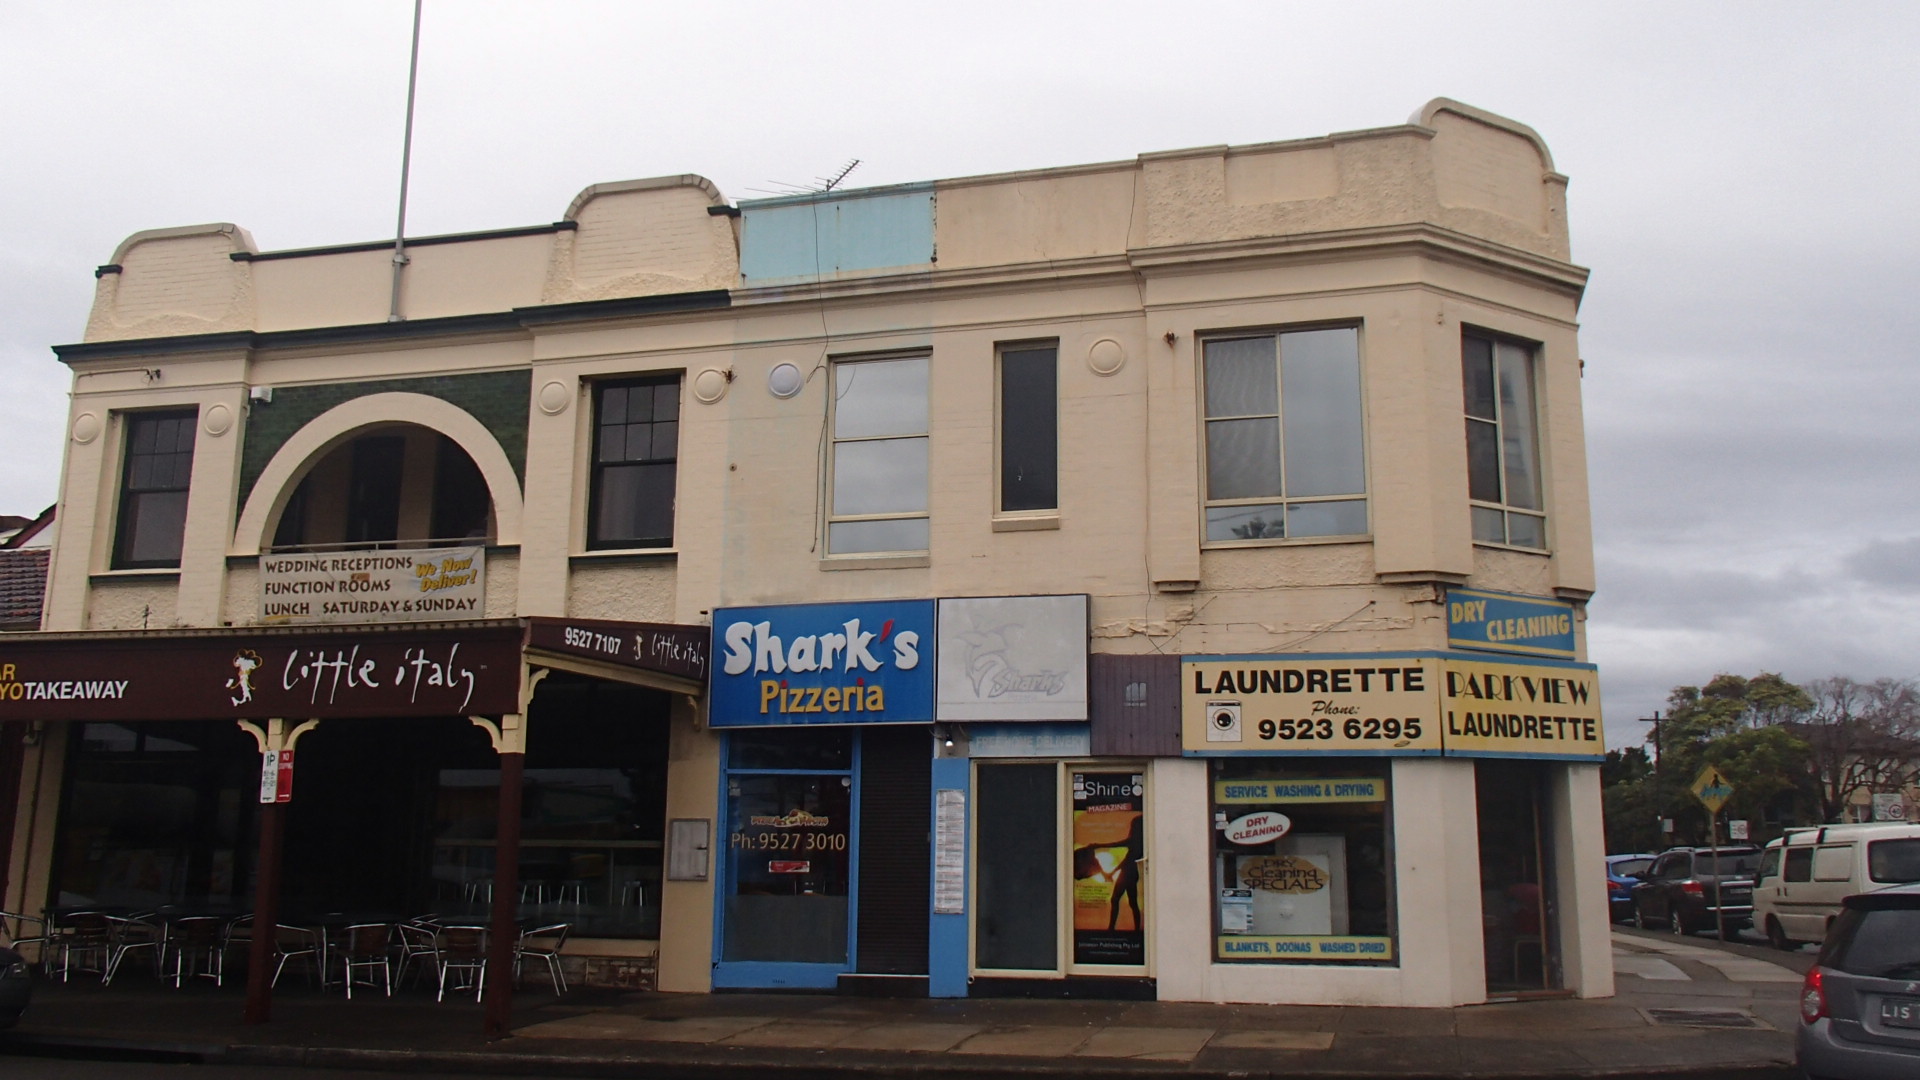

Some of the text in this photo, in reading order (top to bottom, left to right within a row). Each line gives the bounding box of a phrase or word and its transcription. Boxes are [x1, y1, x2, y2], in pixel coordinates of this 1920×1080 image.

[265, 556, 413, 573] WEDDING RECEPTIONS
[416, 557, 474, 578] We Now
[265, 579, 391, 595] FUNCTION ROOMS
[420, 569, 477, 592] Deliver!
[265, 598, 477, 616] LUNCH SATURDAY & SUNDAY
[1451, 600, 1570, 641] DRY CLEANING
[565, 627, 593, 648] 9527
[595, 633, 622, 655] 7107
[723, 618, 919, 677] Shark's
[1195, 667, 1424, 694] LAUNDRETTE
[1446, 671, 1591, 706] PARKVIEW
[760, 677, 884, 714] Pizzeria
[1311, 700, 1360, 716] Phone:
[1258, 718, 1422, 740] 9523 6295
[1448, 711, 1597, 741] LAUNDRETTE
[1085, 781, 1131, 796] Shine
[1225, 783, 1374, 798] SERVICE WASHING & DRYING
[1088, 803, 1128, 813] MAGAZINE
[1246, 816, 1269, 827] DRY
[1233, 824, 1283, 840] CLEANING
[731, 833, 846, 850] Ph: 9527 3010
[1264, 858, 1296, 868] DRY
[1248, 865, 1318, 880] Cleaning
[1243, 878, 1324, 890] SPECIALS
[1225, 942, 1386, 954] BLANKETS, DOONAS WASHED DRIED
[1882, 1005, 1910, 1019] LIS
